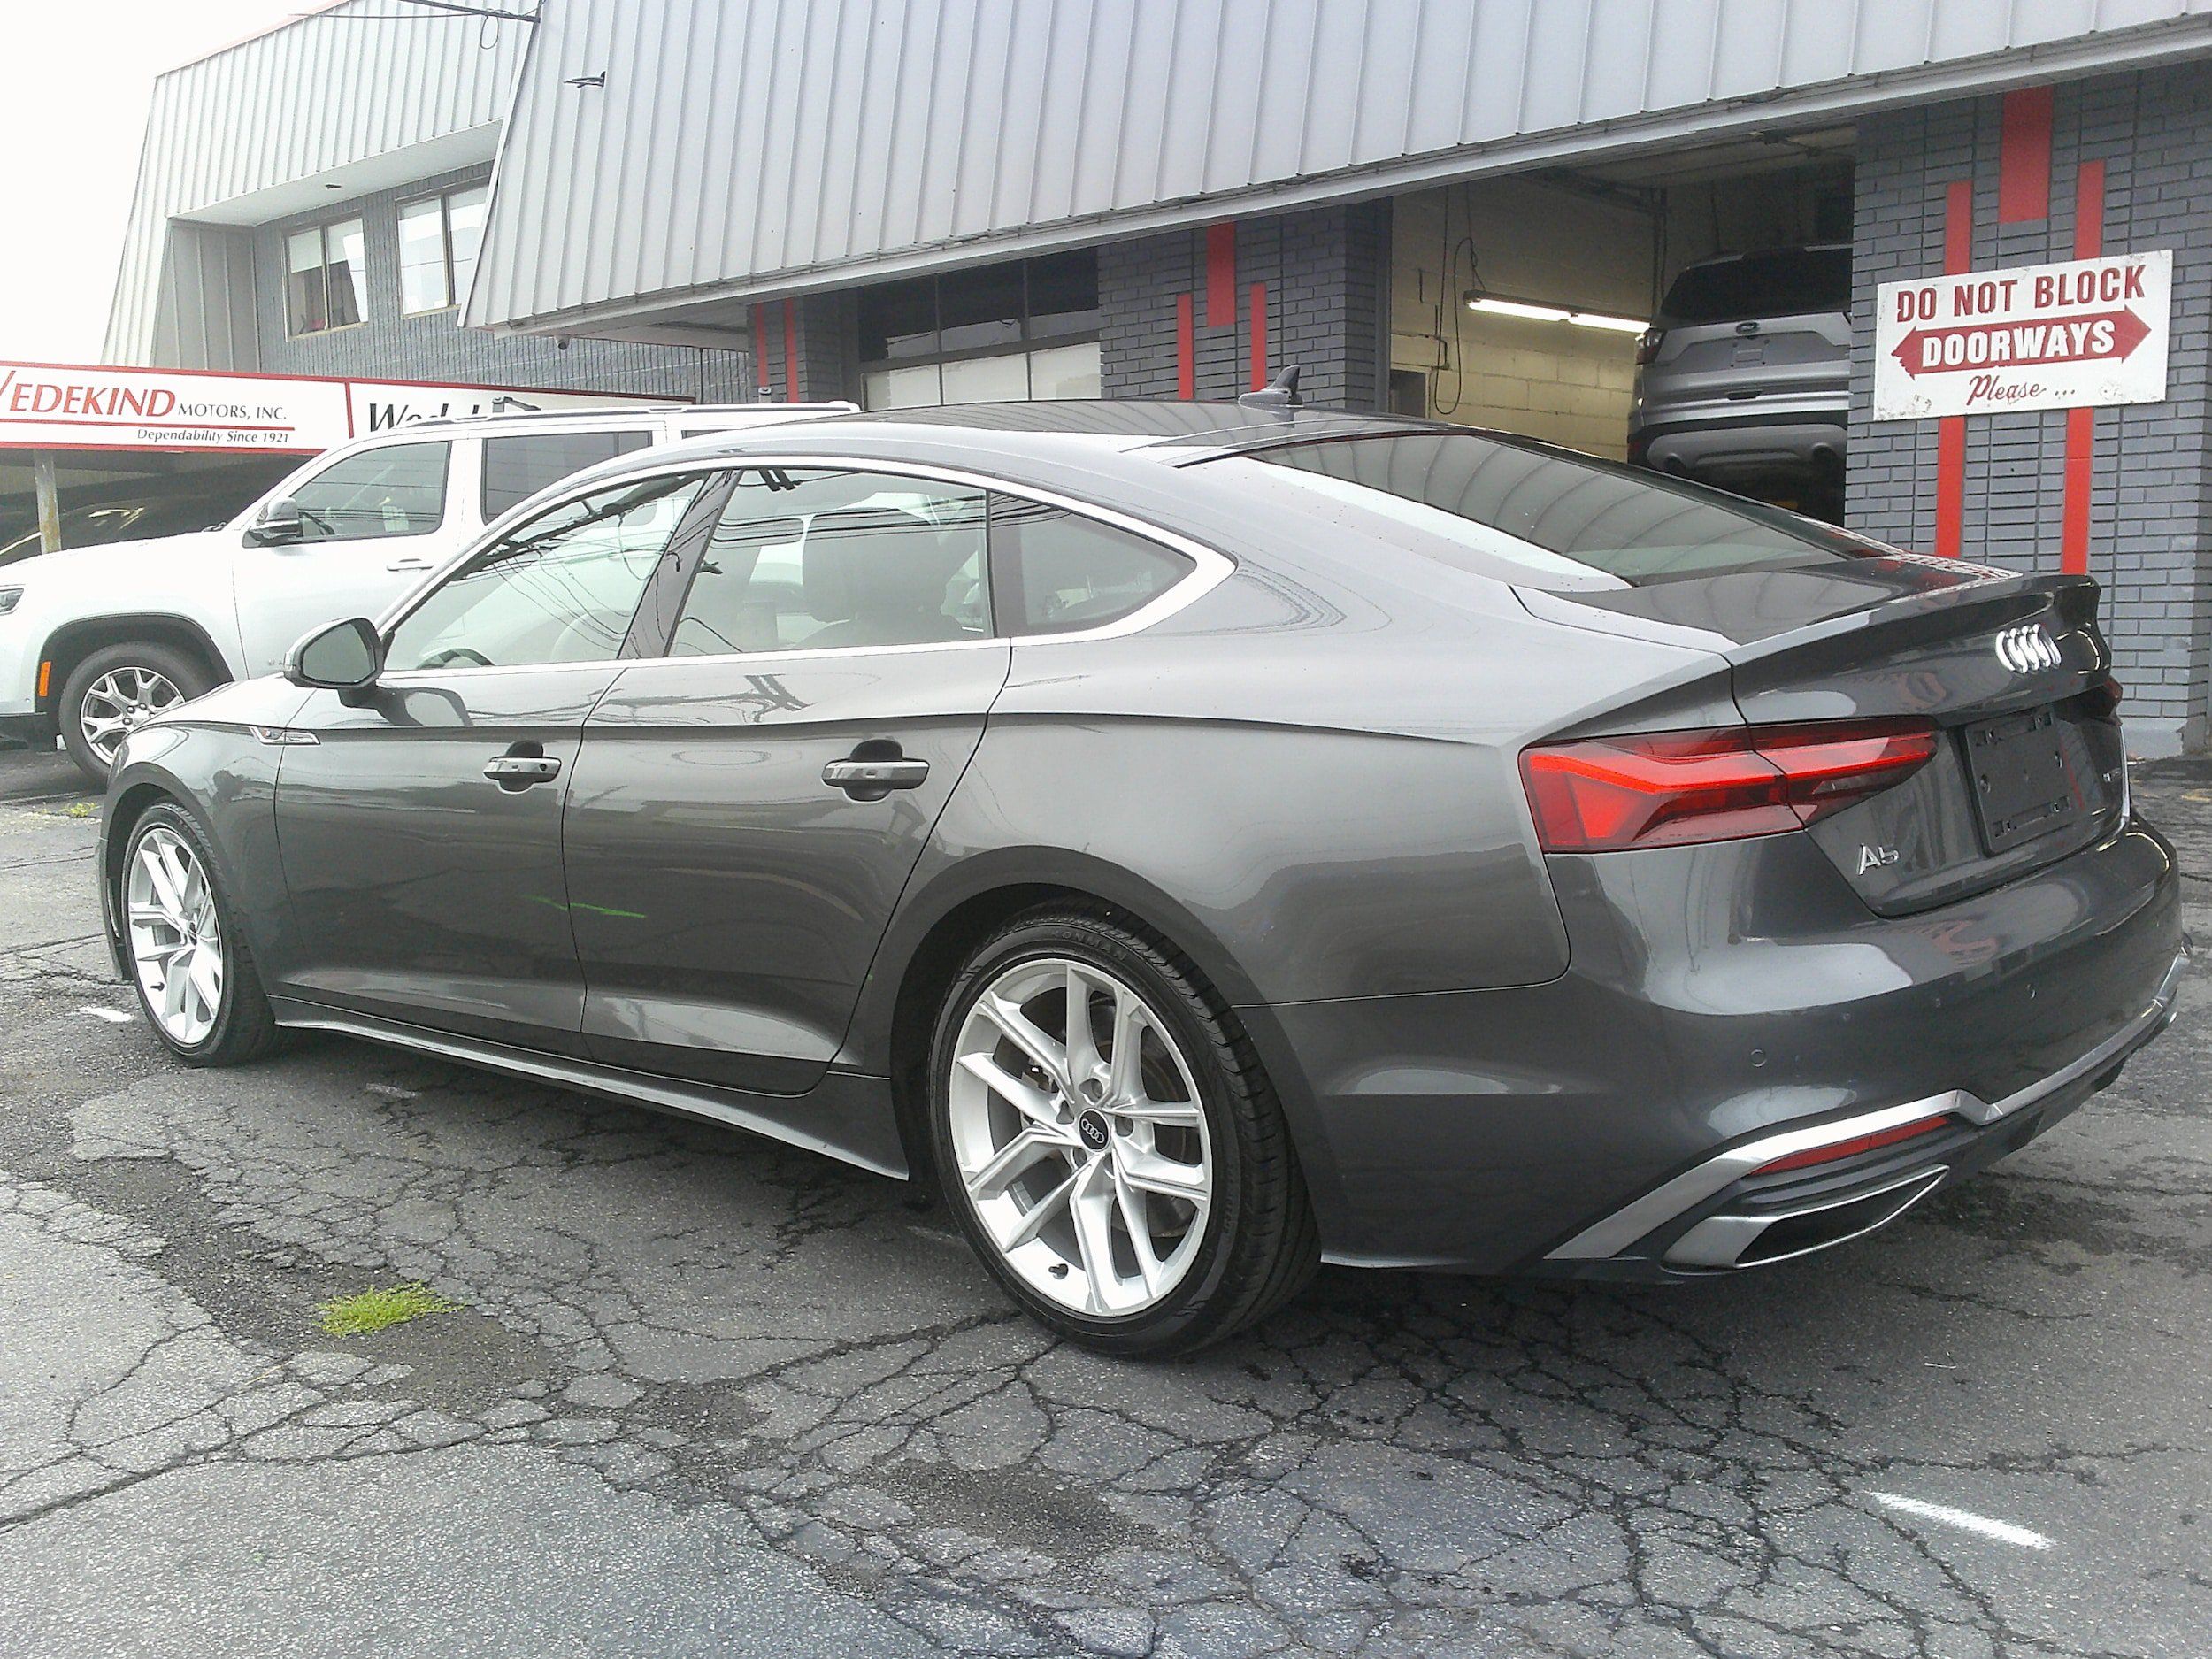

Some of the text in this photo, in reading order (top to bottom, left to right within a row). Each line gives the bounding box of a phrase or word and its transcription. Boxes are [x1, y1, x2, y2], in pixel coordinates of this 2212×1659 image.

[1896, 265, 2147, 322] DO NOT BLOCK
[1921, 319, 2115, 368] DOORWAYS
[0, 371, 287, 420] EDEKIND MOTORS, INC.
[137, 429, 288, 444] Dependability Since 1921
[1857, 843, 1900, 875] A5
